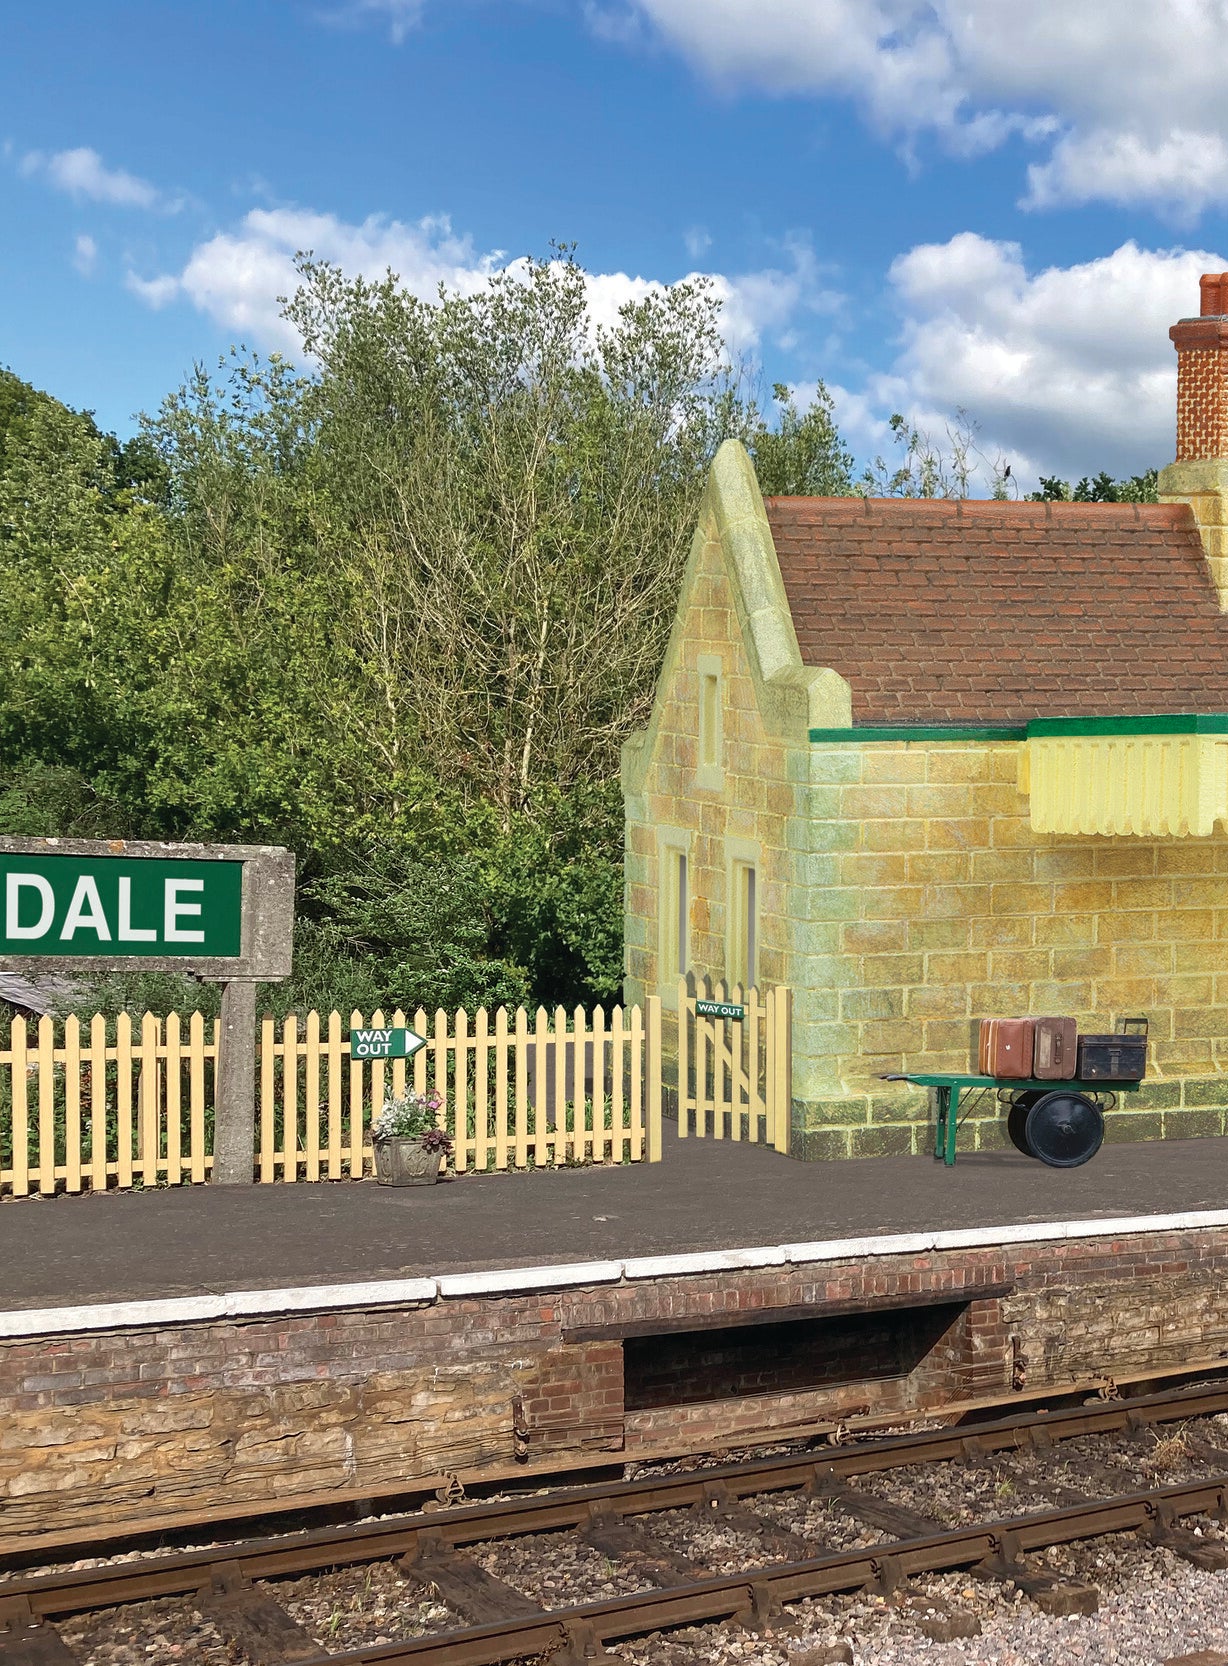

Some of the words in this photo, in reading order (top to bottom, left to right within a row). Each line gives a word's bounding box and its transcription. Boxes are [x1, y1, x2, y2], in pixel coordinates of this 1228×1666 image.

[6, 873, 205, 943] DALE
[698, 1003, 720, 1013] WAY
[721, 1007, 742, 1016] OUT
[356, 1030, 393, 1042] WAY
[356, 1043, 392, 1056] OUT
